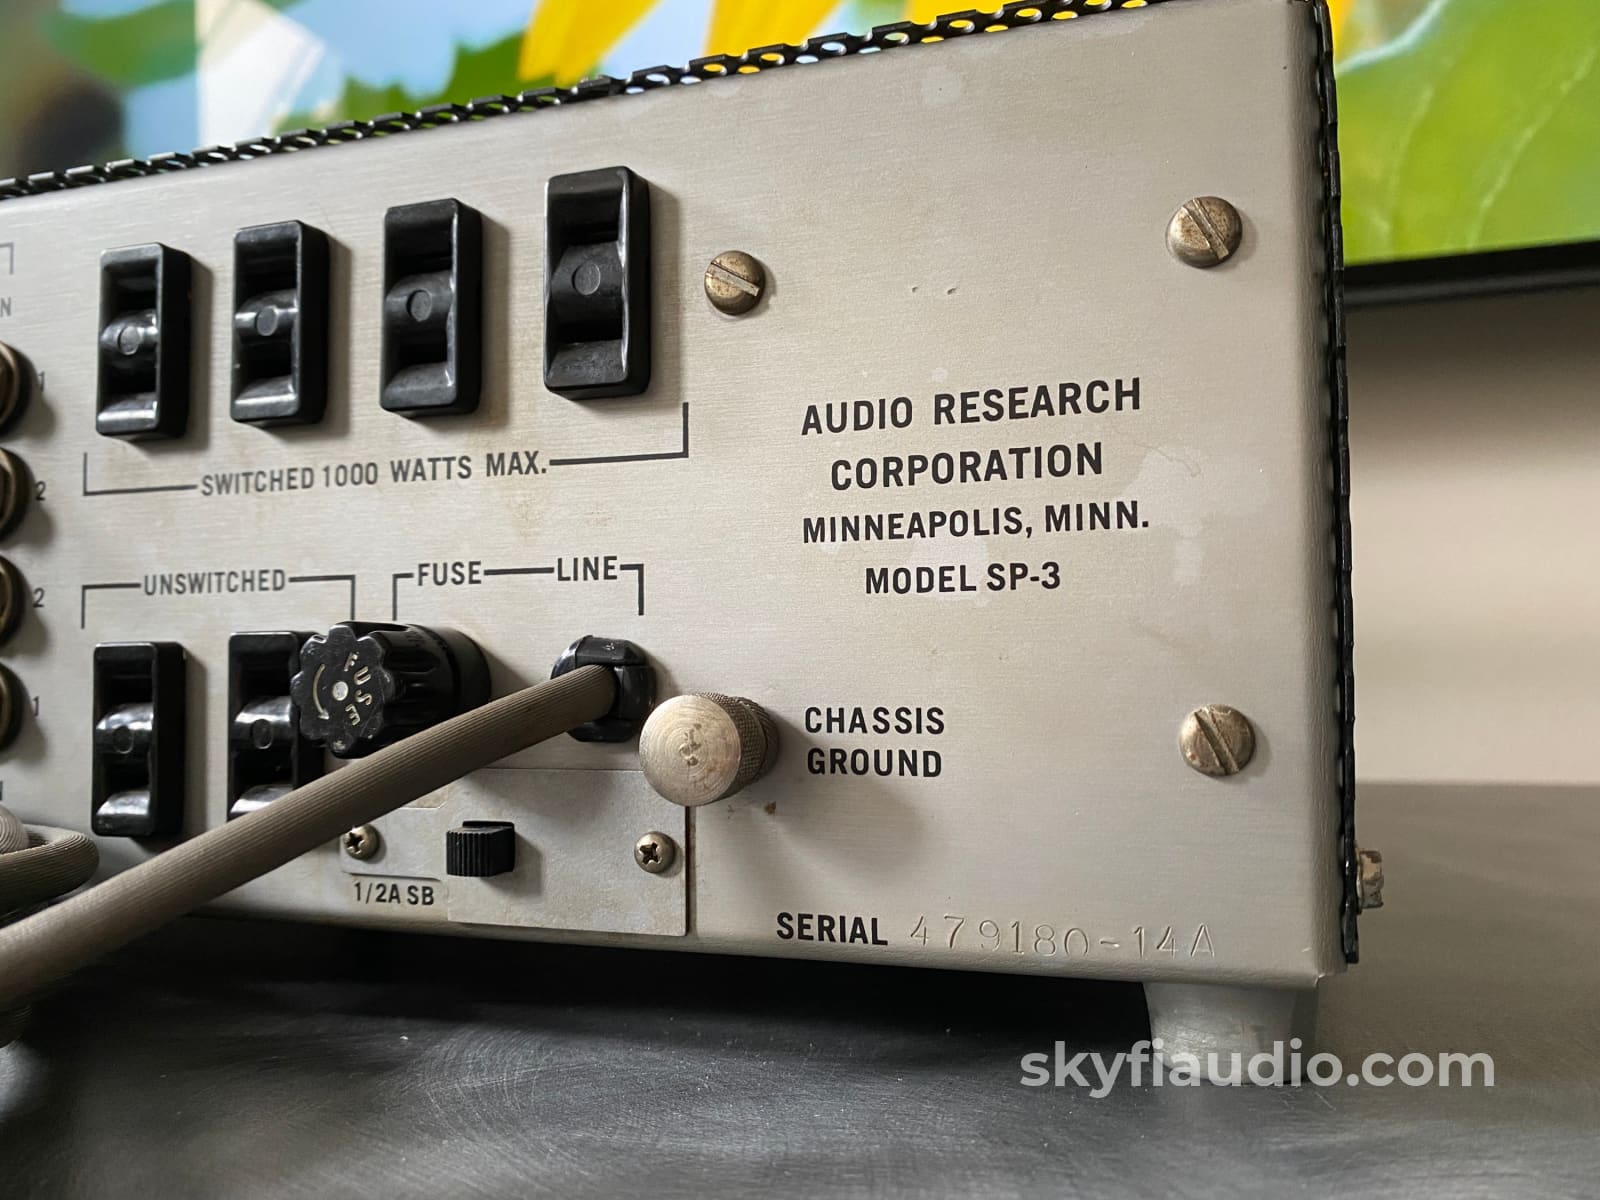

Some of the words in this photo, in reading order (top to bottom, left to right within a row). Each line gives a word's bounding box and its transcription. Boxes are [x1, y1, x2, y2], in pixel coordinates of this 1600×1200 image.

[801, 396, 913, 436] AUDIO
[933, 377, 1141, 426] RESEARCH
[201, 466, 315, 497] SWITCHED
[322, 462, 379, 489] 1000
[390, 456, 473, 484] WATTS
[485, 450, 548, 477] MAX.
[831, 442, 1103, 491] CORPORATION
[35, 481, 46, 501] 2
[803, 506, 1034, 544] MINNEAPOLIS,
[1044, 499, 1150, 534] MINN.
[143, 568, 287, 596] UNSWITCHED
[416, 562, 483, 587] FUSE
[556, 556, 619, 582] LINE
[866, 564, 977, 595] MODEL
[986, 561, 1061, 592] SP-3
[32, 587, 45, 608] 2
[32, 696, 40, 718] 1
[804, 706, 945, 735] CHASSIS
[807, 748, 942, 778] GROUND
[353, 882, 401, 905] 1/2A
[406, 886, 436, 906] SB
[776, 912, 889, 946] SERIAL
